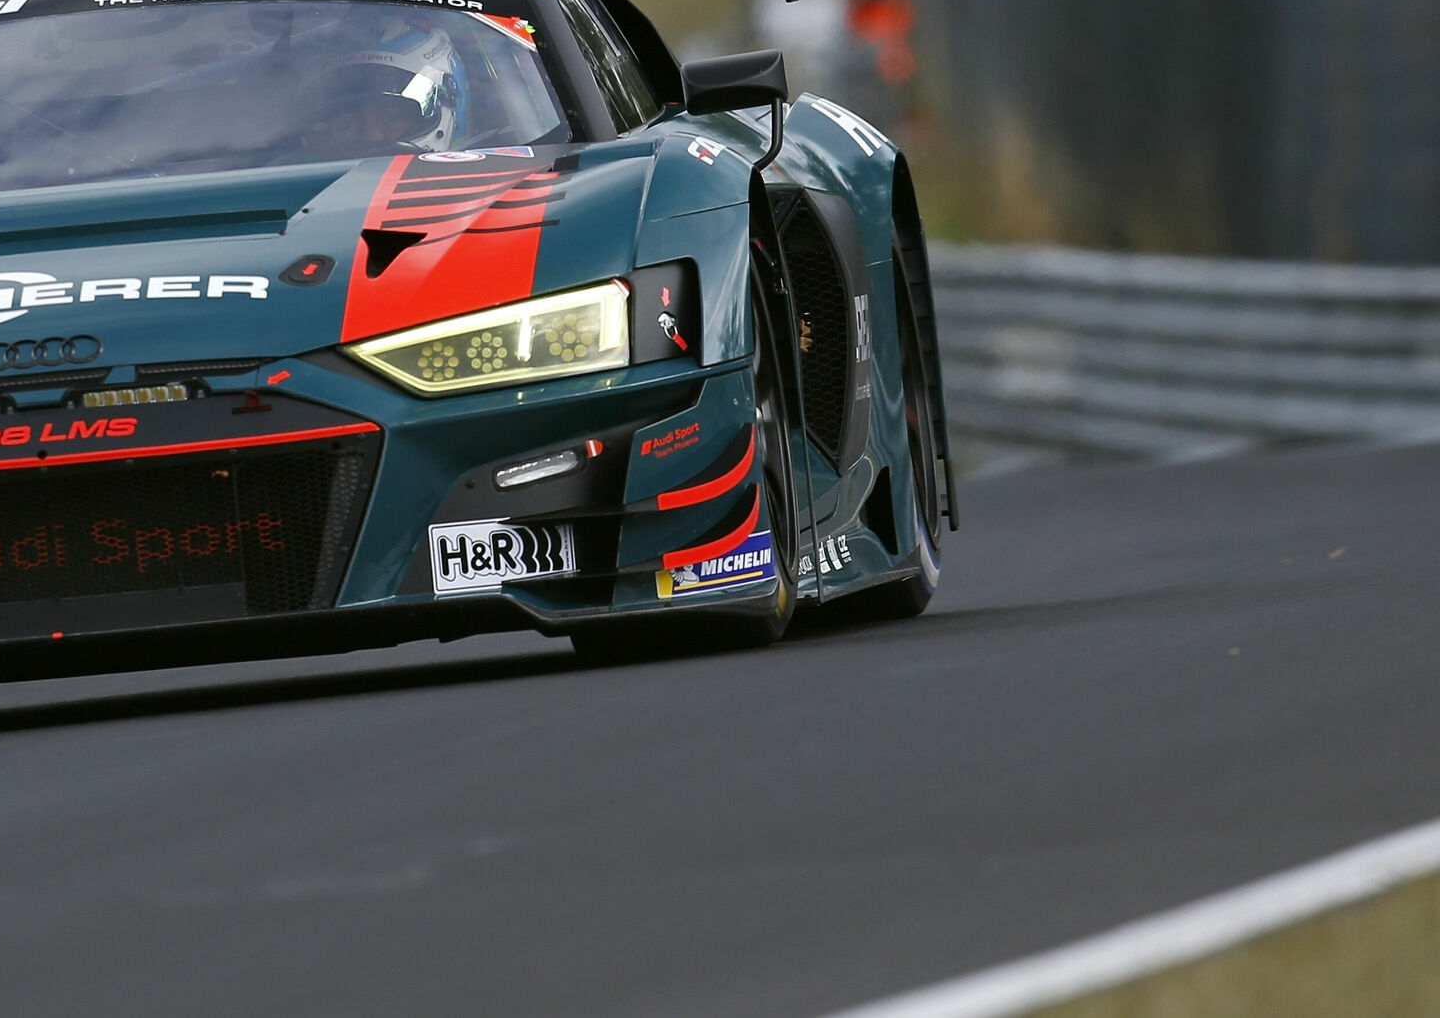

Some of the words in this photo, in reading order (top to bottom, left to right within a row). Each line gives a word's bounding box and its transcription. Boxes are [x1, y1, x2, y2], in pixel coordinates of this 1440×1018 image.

[40, 417, 139, 443] LMS
[652, 431, 675, 449] Audi
[674, 422, 701, 440] Sport
[91, 512, 285, 573] Sport
[440, 532, 517, 577] H&R
[700, 546, 772, 577] MICHELIN
